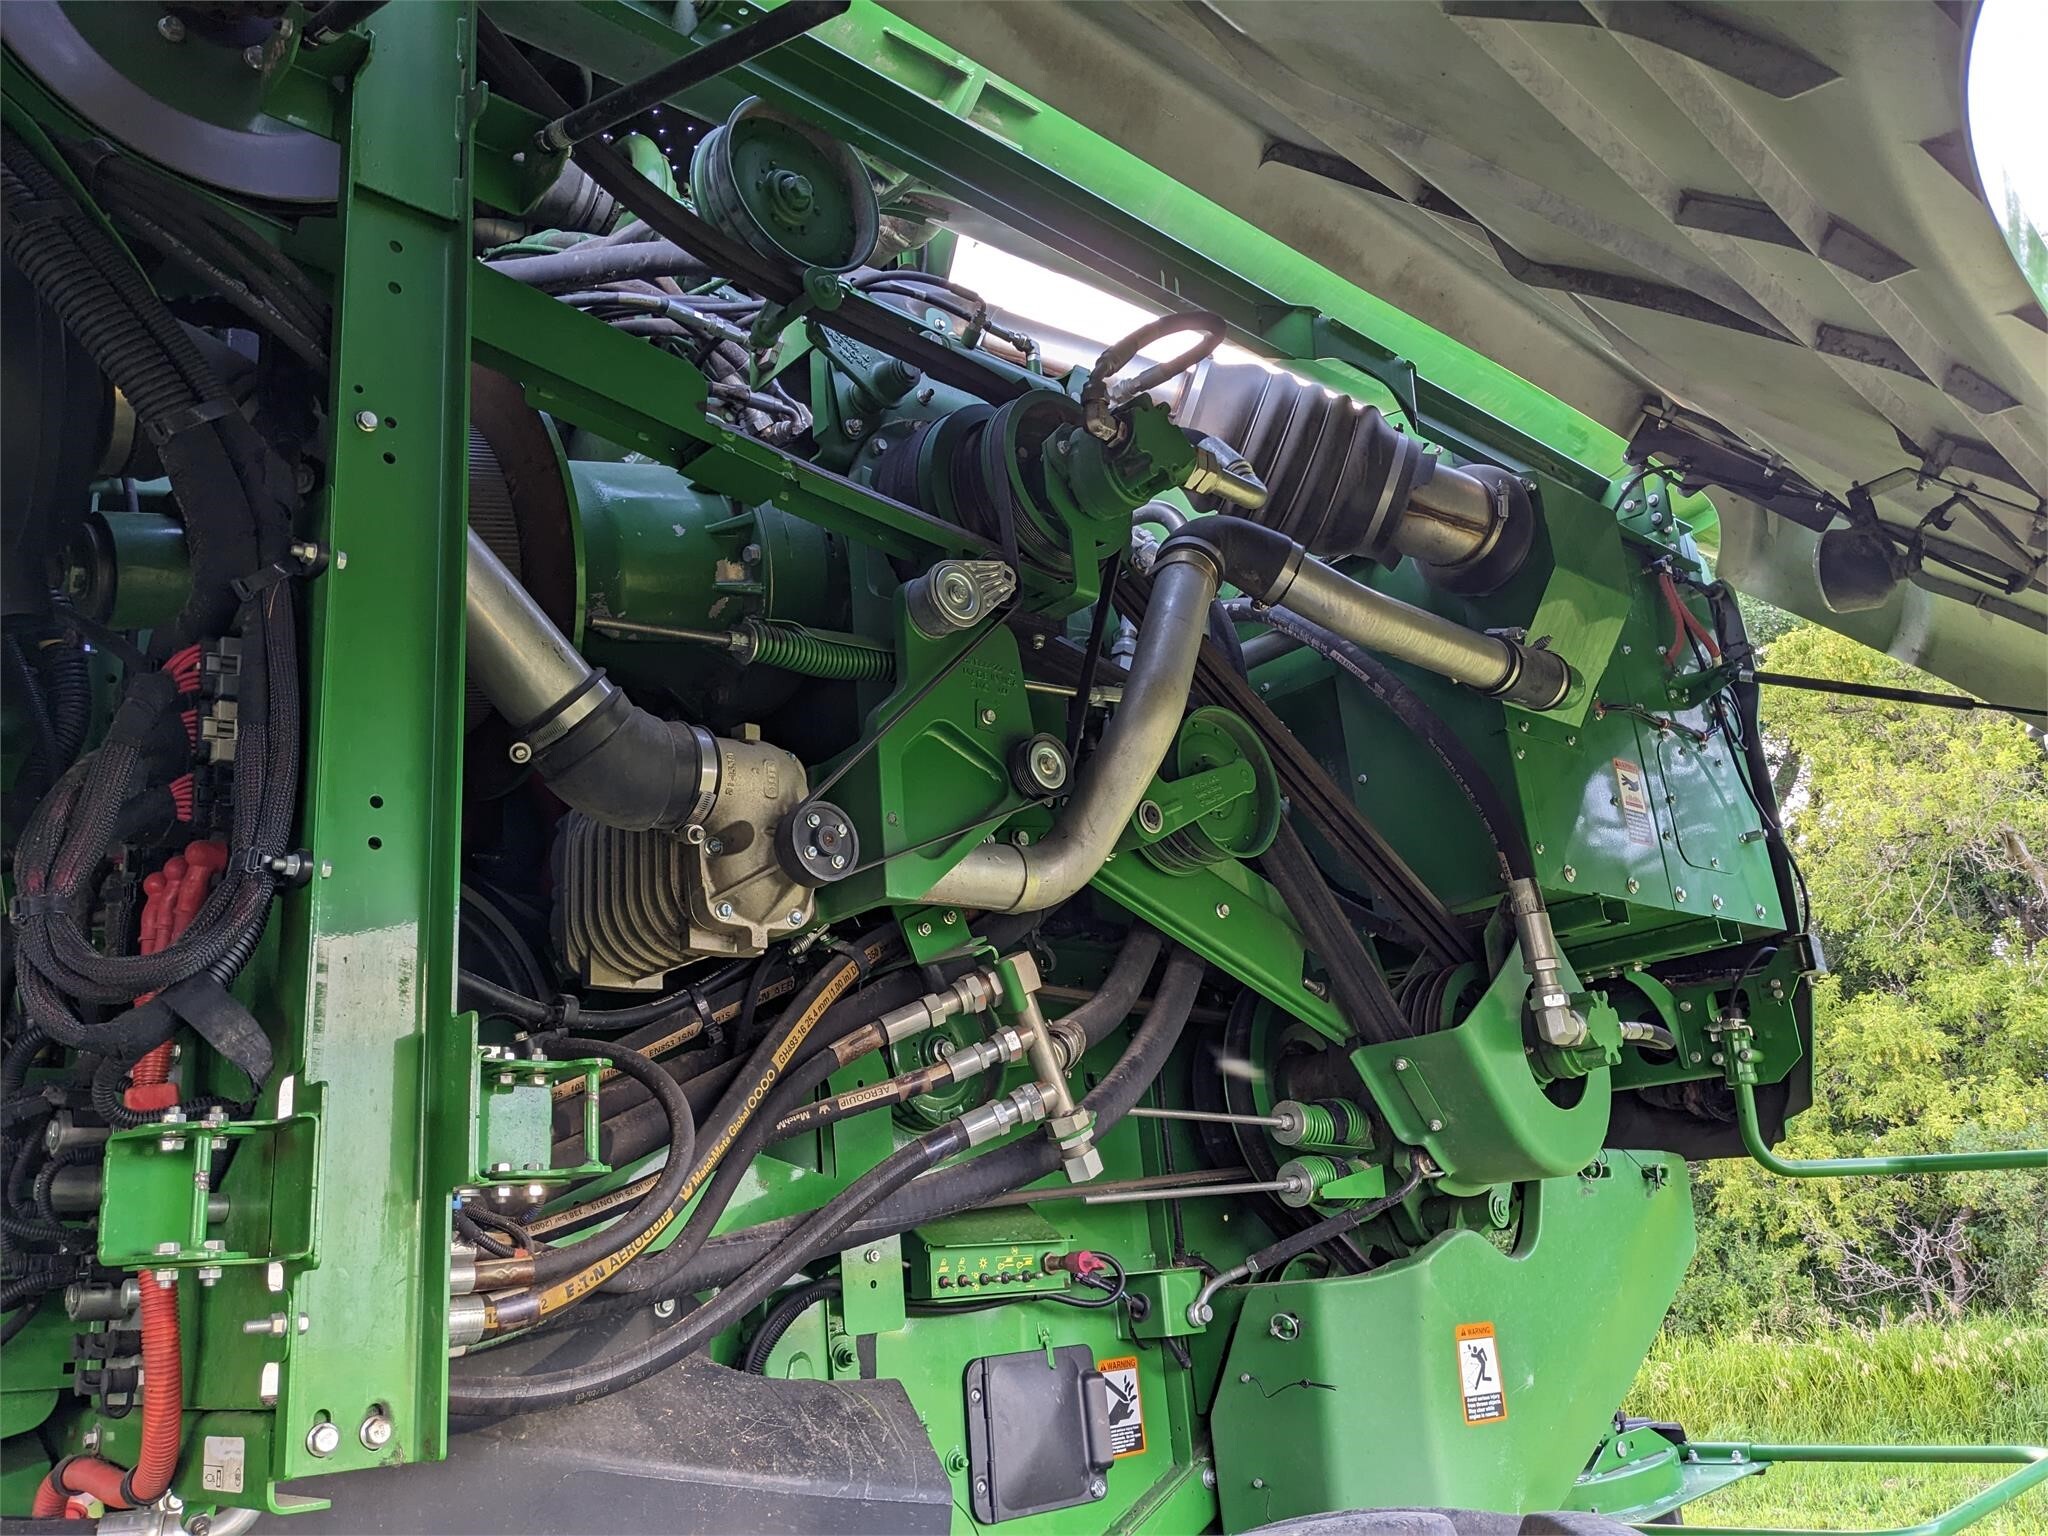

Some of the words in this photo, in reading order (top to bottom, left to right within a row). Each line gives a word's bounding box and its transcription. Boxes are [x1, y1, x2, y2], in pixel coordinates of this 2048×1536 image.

[840, 1085, 890, 1107] AEROQUIP
[690, 1136, 731, 1187] MatchMate
[728, 1106, 751, 1138] Global
[609, 1208, 673, 1272] AEROQUIP
[1468, 1326, 1491, 1335] WARNING
[1106, 1359, 1136, 1371] WARNING
